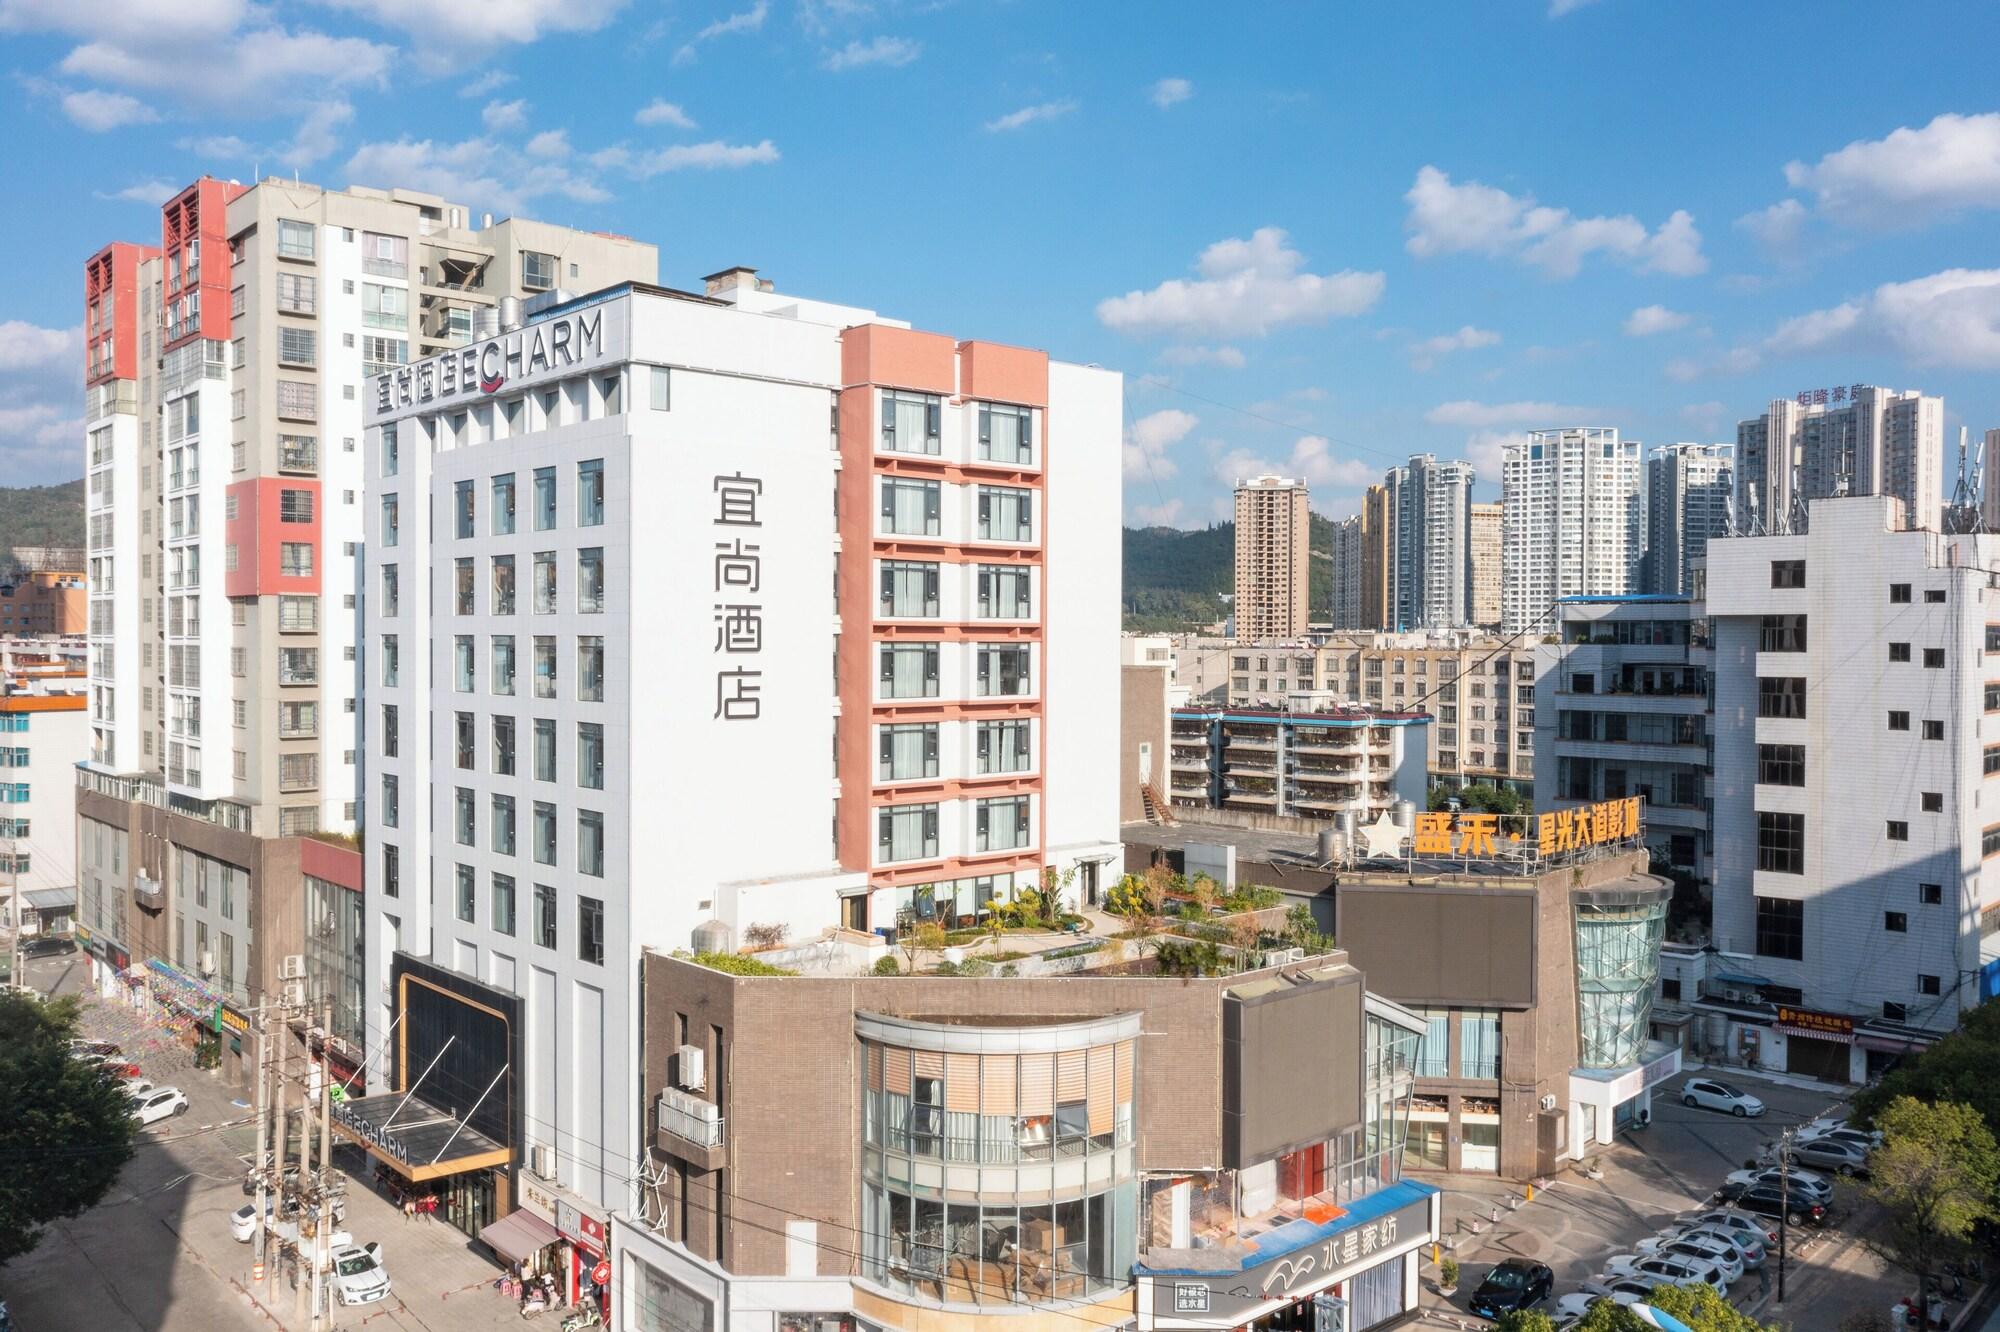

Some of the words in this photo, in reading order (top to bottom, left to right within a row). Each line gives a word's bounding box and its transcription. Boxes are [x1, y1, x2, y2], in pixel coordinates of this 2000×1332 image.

[377, 353, 457, 414] 宜尚酒店
[463, 308, 604, 392] ECHARM
[713, 470, 763, 720] 宜尚酒店
[1540, 796, 1639, 856] 星光大道影城
[1322, 1215, 1397, 1271] 水星家纺
